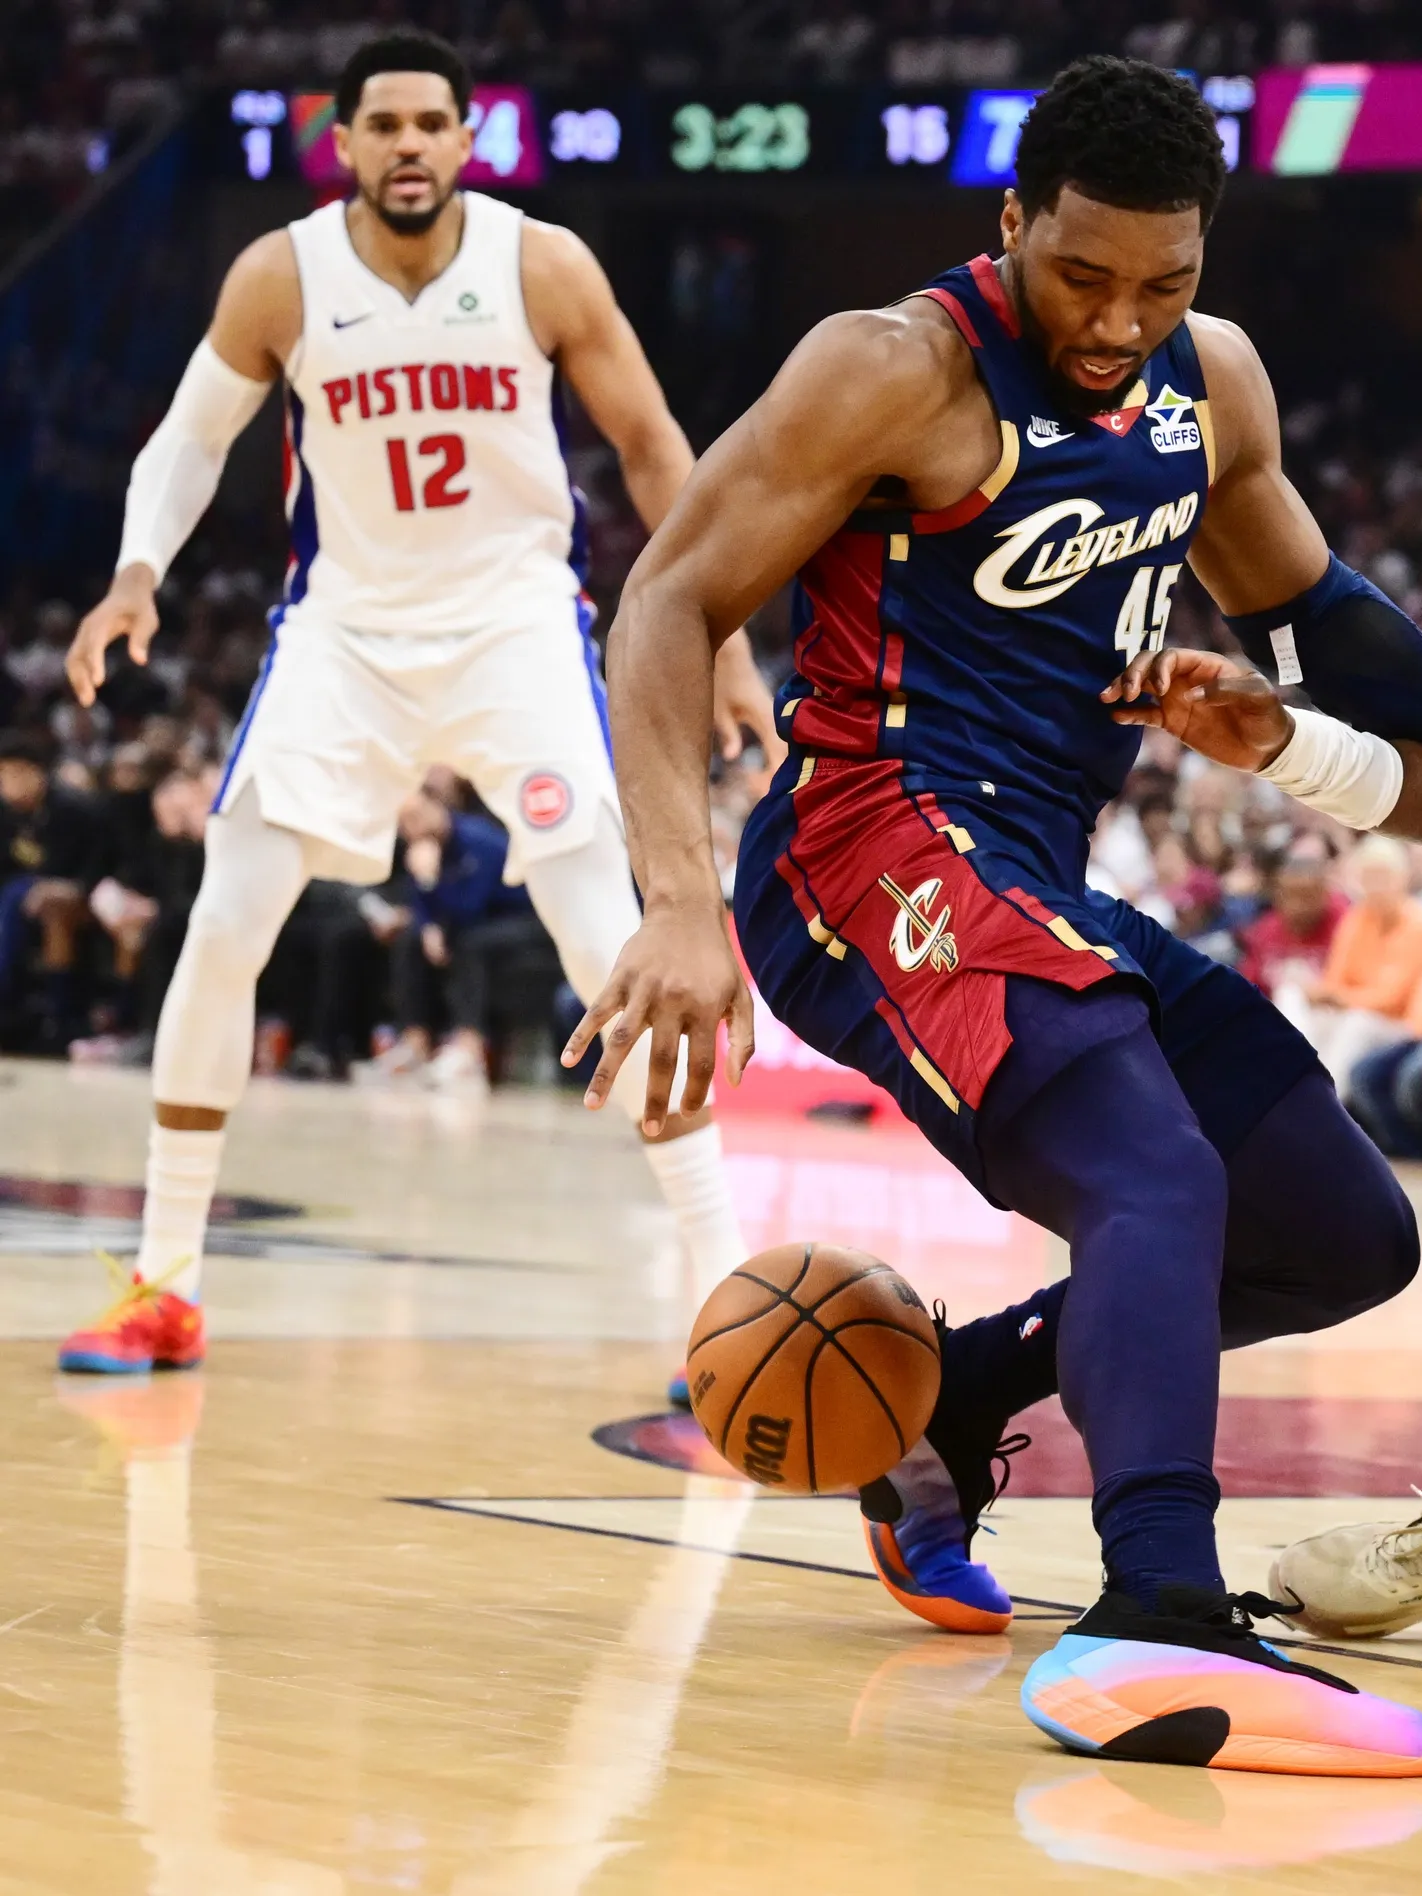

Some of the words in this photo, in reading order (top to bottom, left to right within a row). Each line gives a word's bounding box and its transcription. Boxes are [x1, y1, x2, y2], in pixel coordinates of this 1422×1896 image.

[672, 102, 809, 171] 3:23
[322, 363, 519, 424] PISTONS
[1110, 415, 1123, 431] C
[1030, 415, 1060, 437] NIKE
[1154, 428, 1199, 447] CLIFFS
[387, 433, 470, 511] 12
[973, 491, 1199, 609] CLEVELAND
